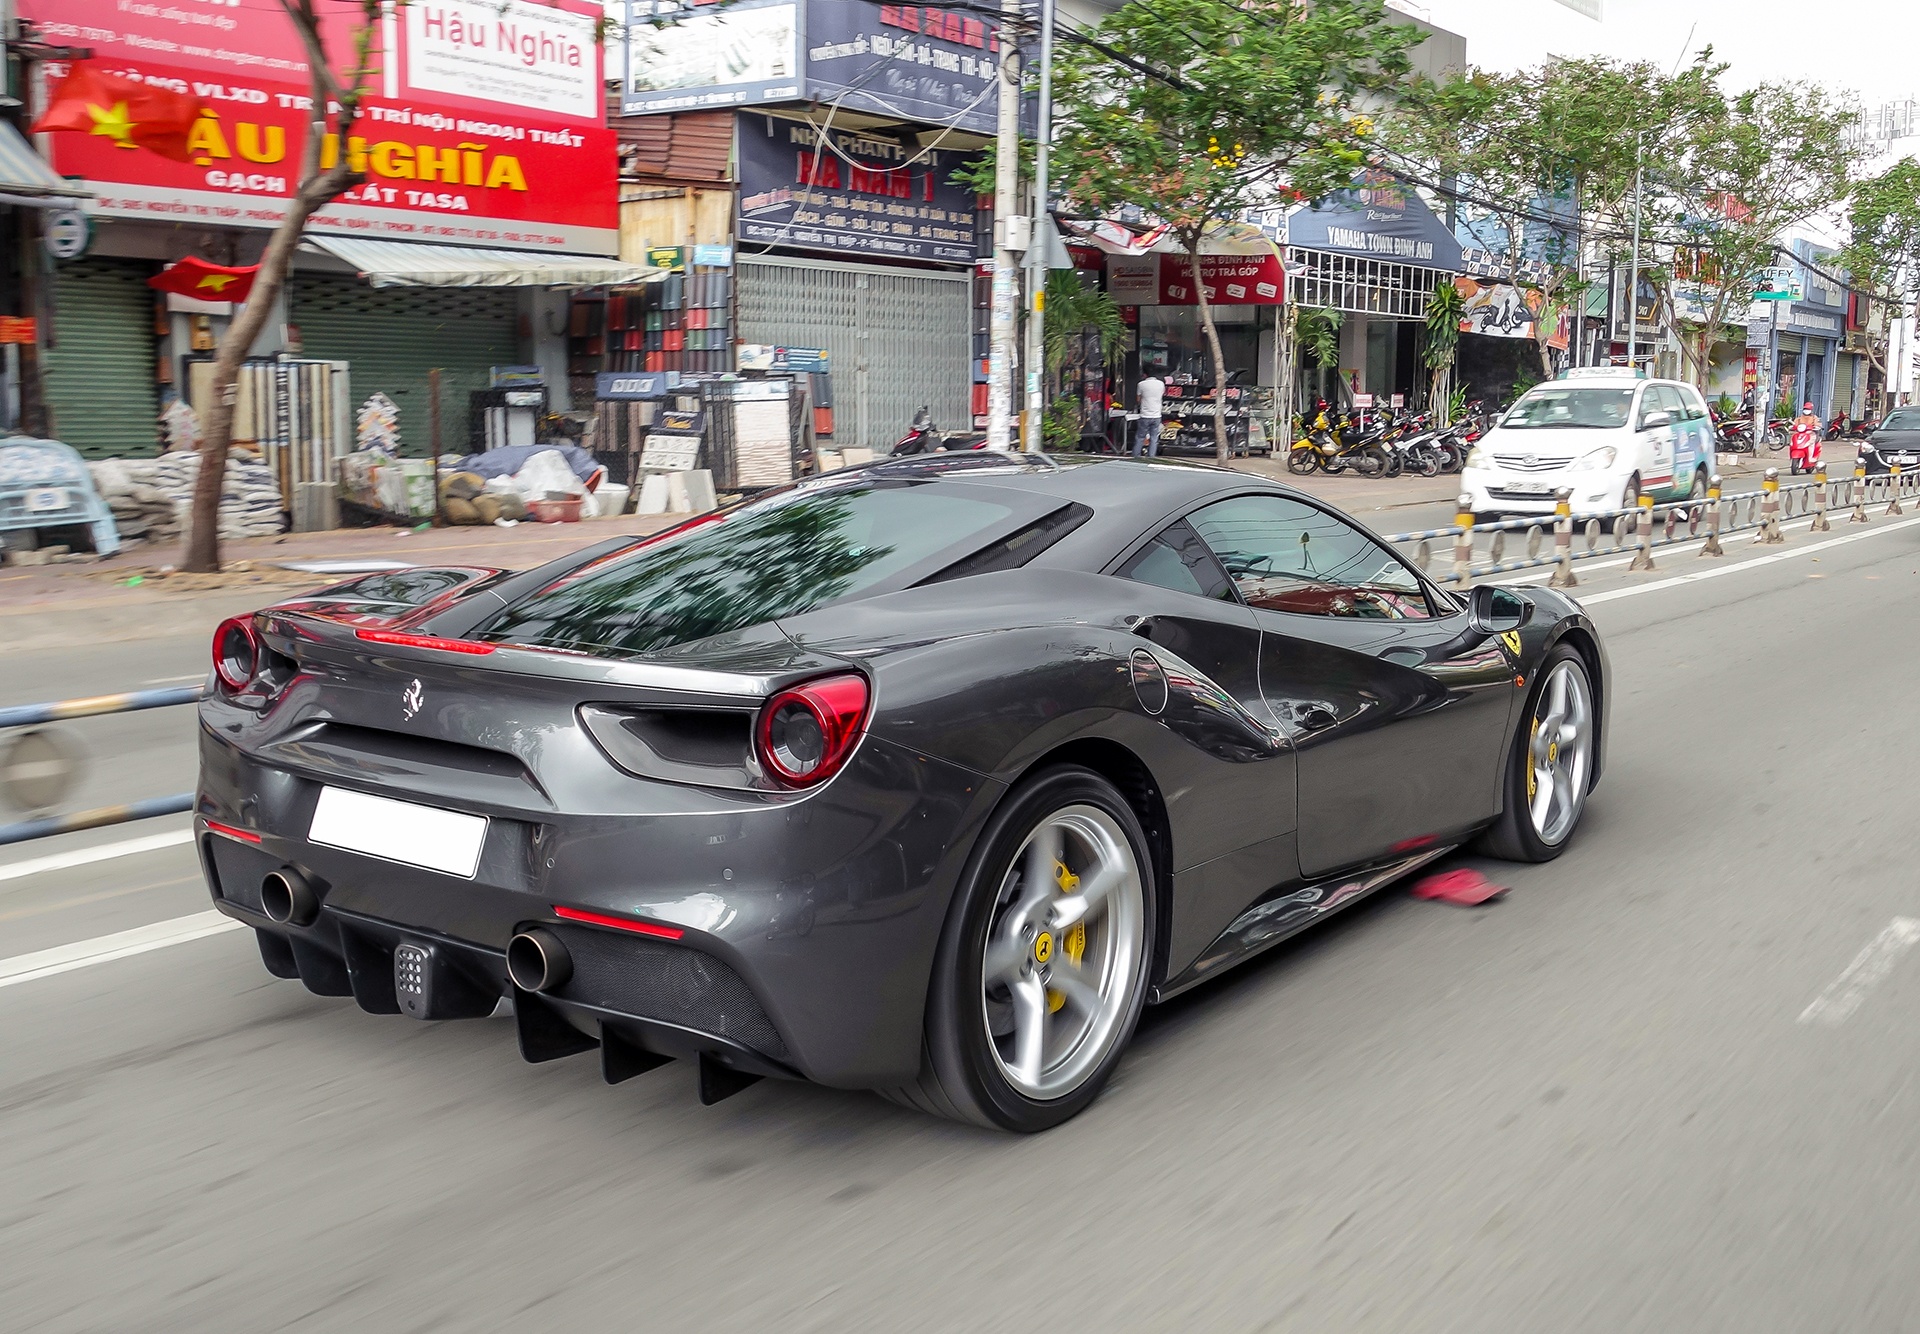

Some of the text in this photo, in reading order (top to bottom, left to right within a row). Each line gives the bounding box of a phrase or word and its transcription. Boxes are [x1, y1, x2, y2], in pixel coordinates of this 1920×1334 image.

[424, 7, 486, 50] Hậu
[497, 21, 582, 67] Nghĩa
[192, 81, 269, 105] VLXD
[367, 106, 413, 125] TRÍ
[412, 112, 455, 133] NỘI
[456, 118, 526, 142] NGOẠI
[527, 129, 586, 148] THẤT
[205, 170, 287, 194] GẠCH
[404, 190, 469, 211] TASA
[1244, 255, 1266, 264] ANH
[1326, 226, 1367, 251] YAMAHA
[1366, 233, 1394, 254] TOWN
[1415, 241, 1434, 260] ANH
[1238, 263, 1259, 277] GÓP
